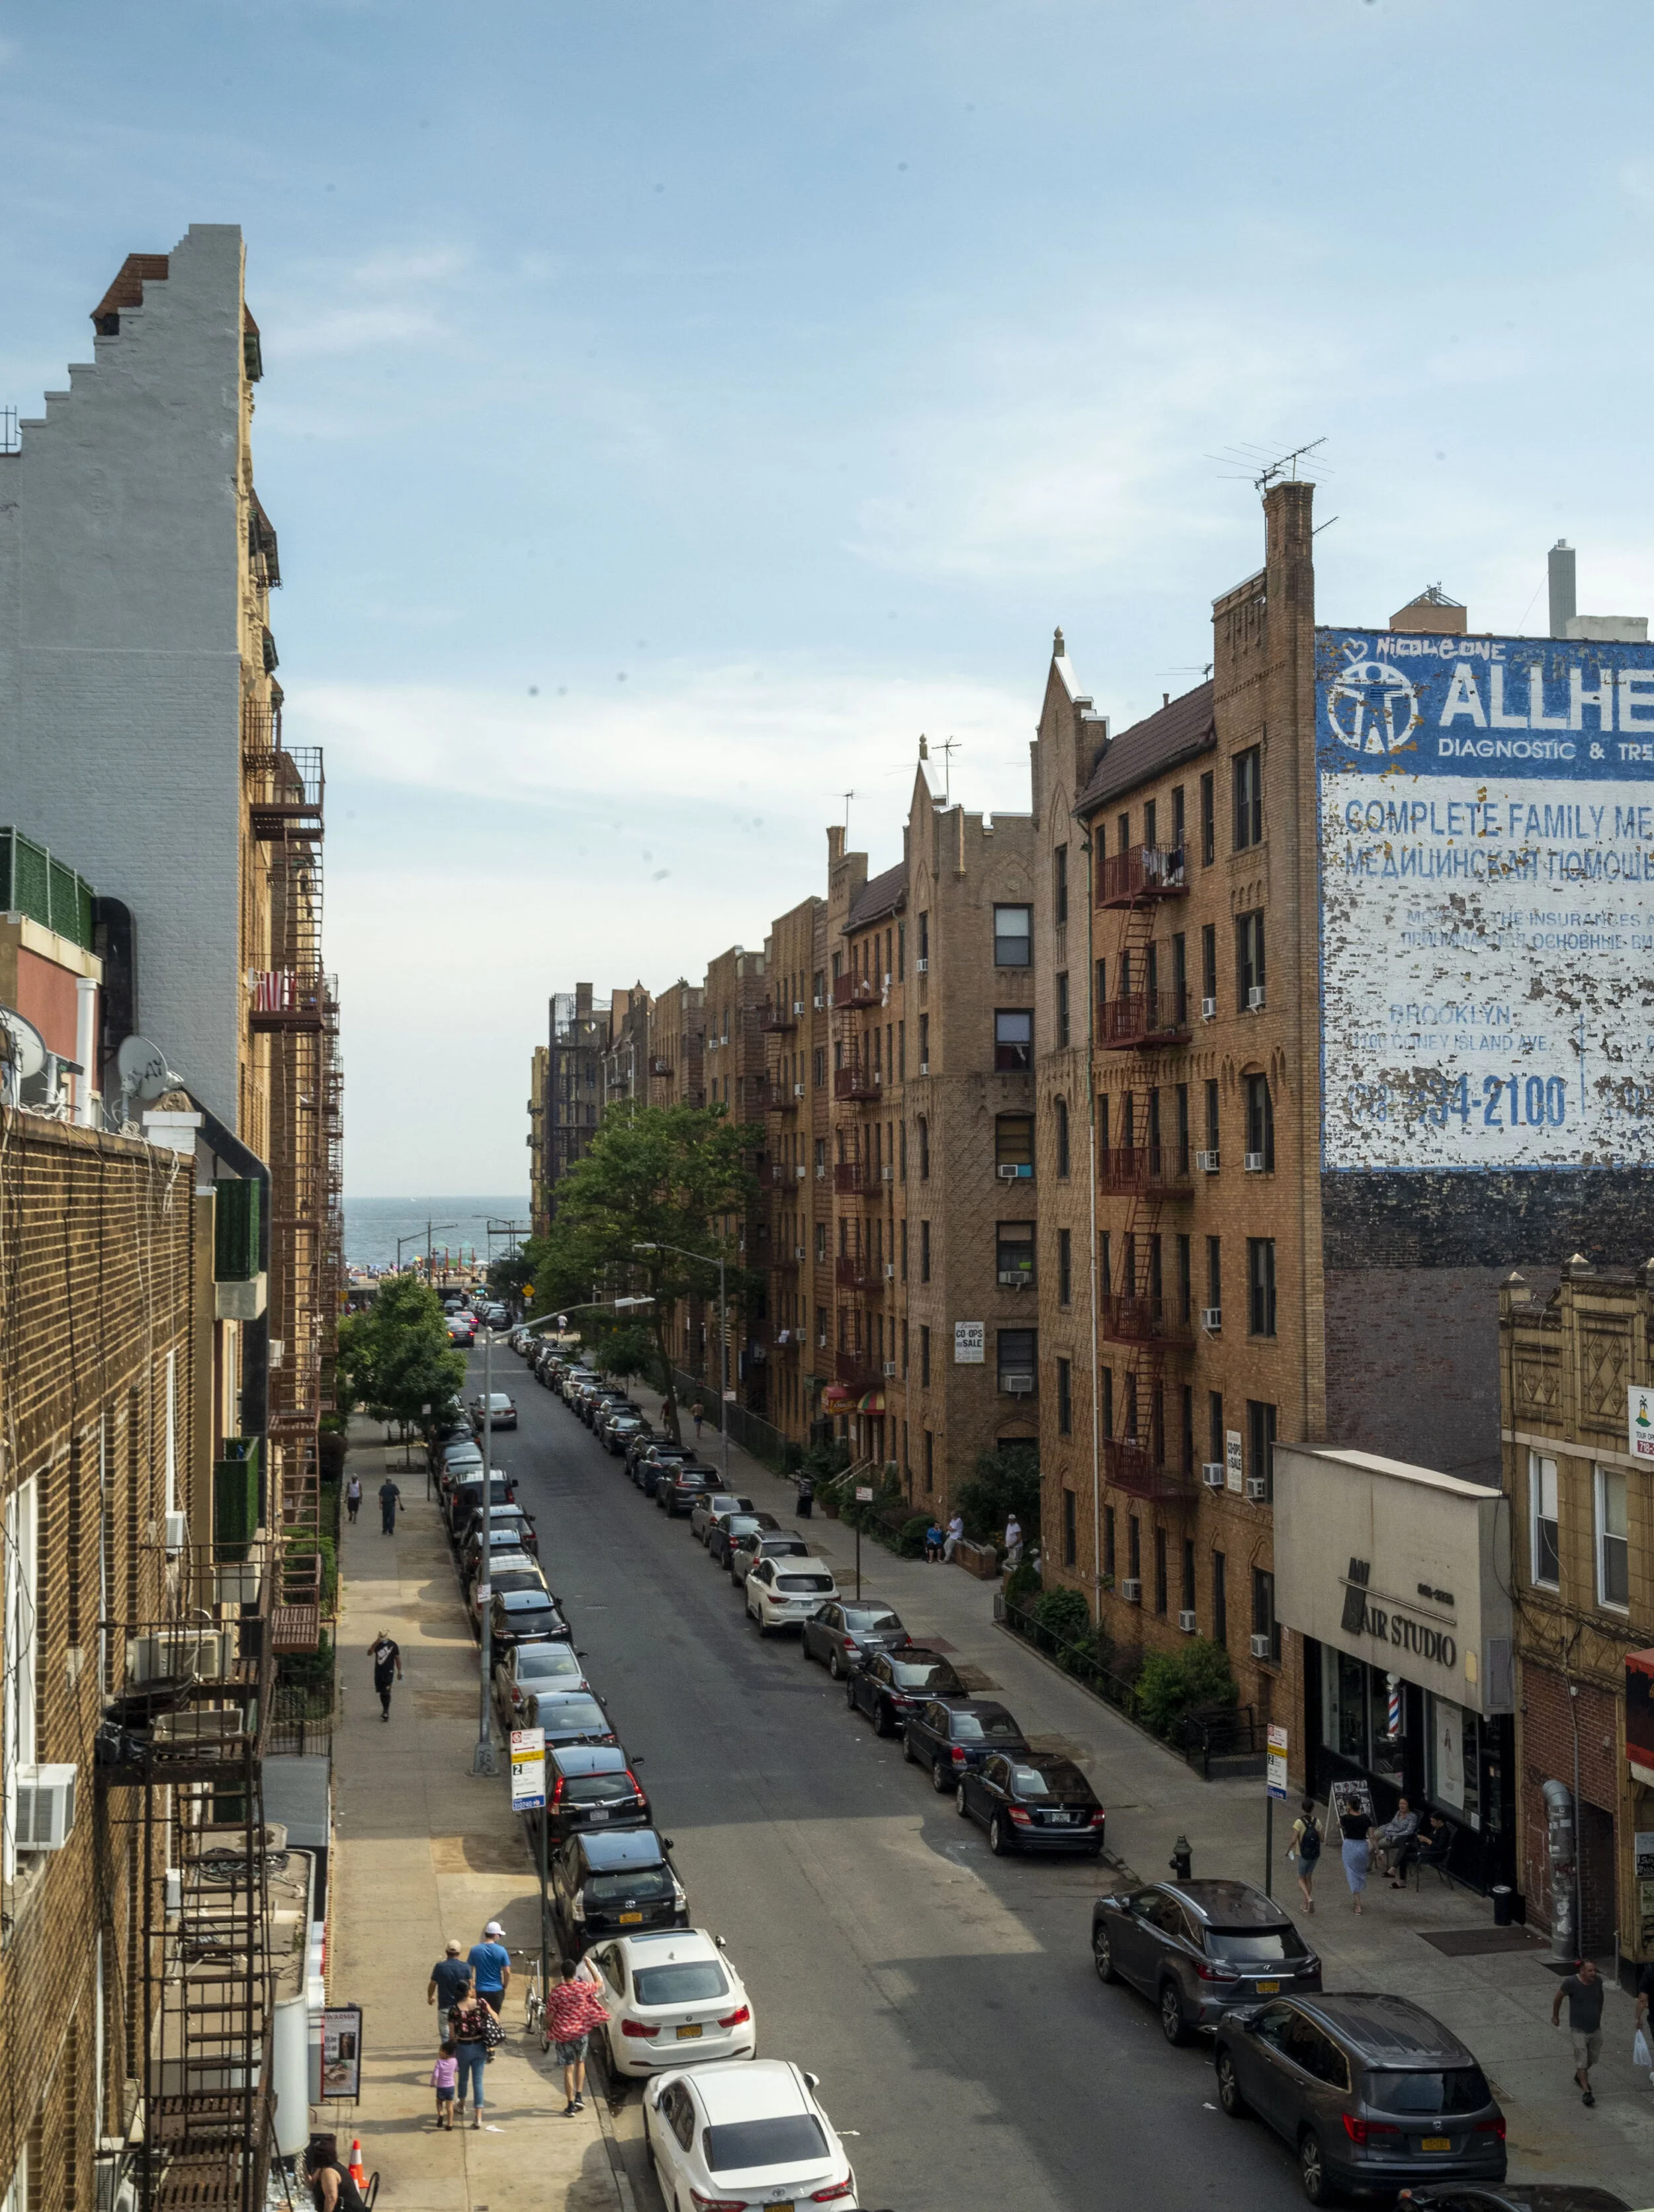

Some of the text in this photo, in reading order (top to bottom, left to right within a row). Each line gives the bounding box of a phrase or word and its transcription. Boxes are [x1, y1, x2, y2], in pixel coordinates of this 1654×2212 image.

[1438, 663, 1654, 732] ALLHE
[1438, 738, 1654, 761] DIAGNOSTIC & TRE
[1345, 799, 1654, 841] COMPLETE FAMILY ME
[1345, 845, 1538, 880] МЕДИЦИНСКАЯ
[1530, 912, 1641, 927] INSURANCES
[1532, 932, 1622, 949] ОСНОВНЫЕ
[1390, 1004, 1510, 1025] BROOKLYN
[1392, 1033, 1449, 1050] CONEY
[1456, 1034, 1513, 1050] ISLAND
[963, 1340, 982, 1348] SALE
[1391, 1614, 1457, 1668] STUDIO
